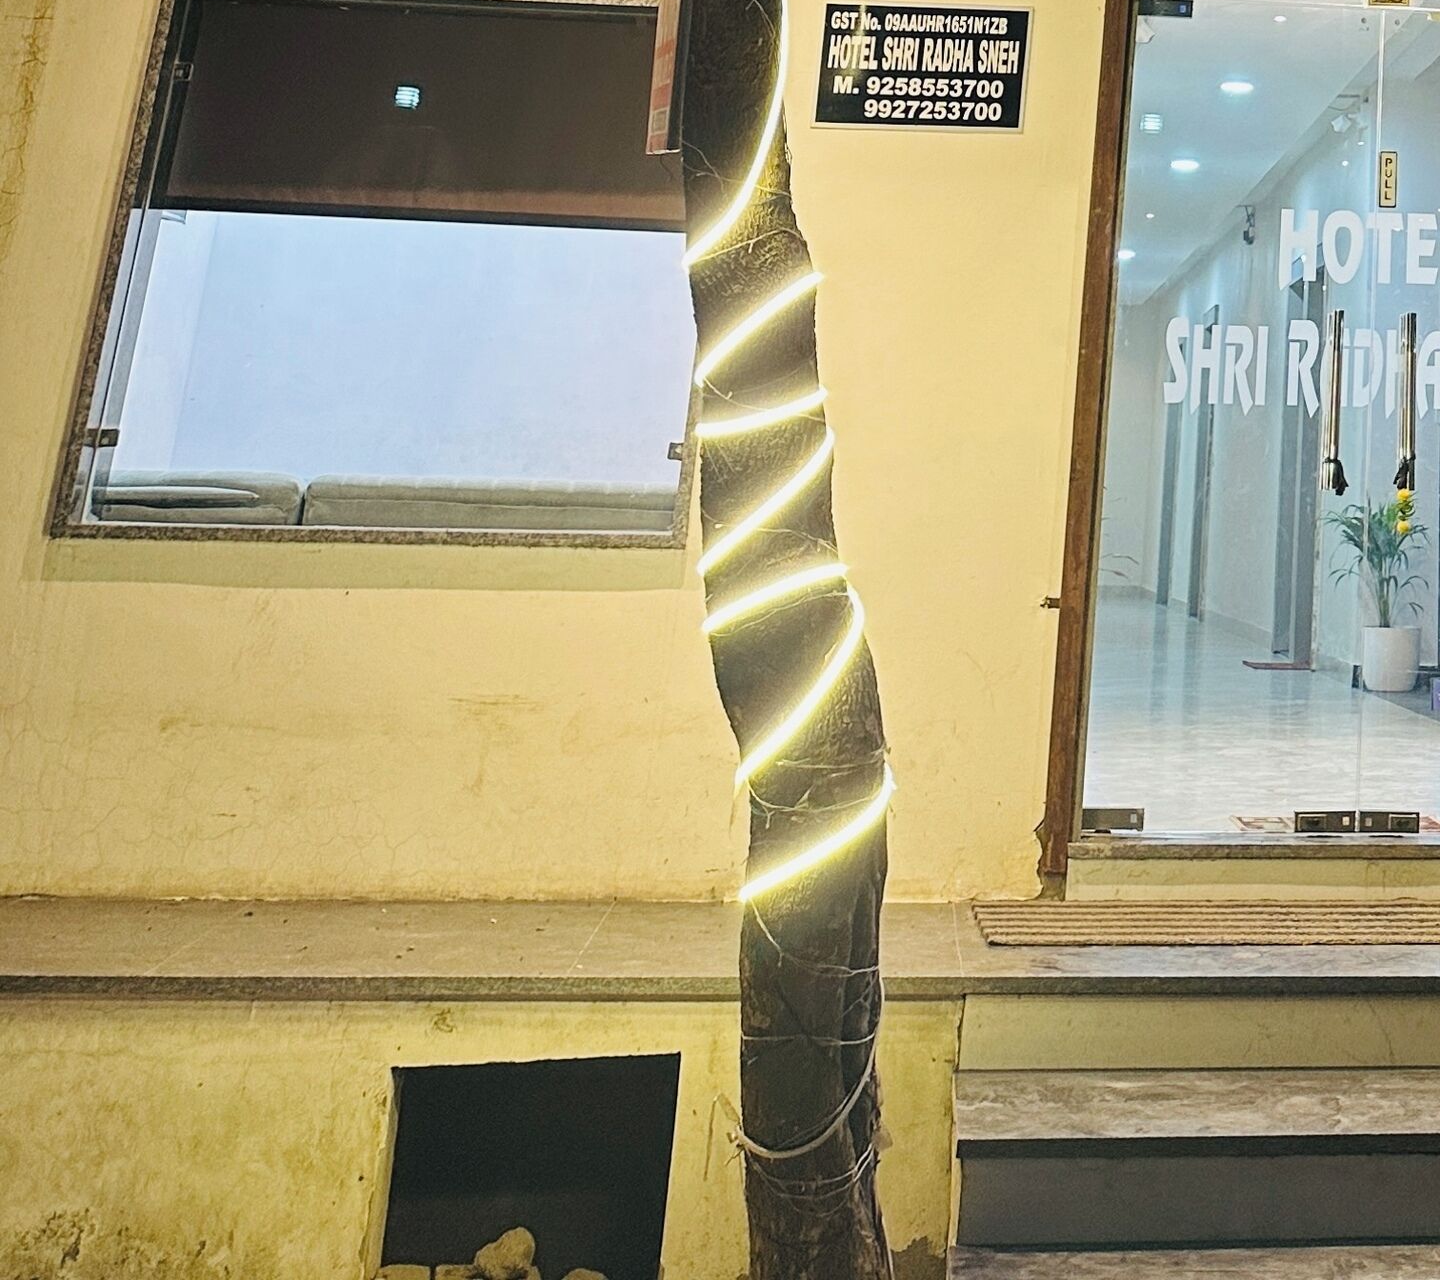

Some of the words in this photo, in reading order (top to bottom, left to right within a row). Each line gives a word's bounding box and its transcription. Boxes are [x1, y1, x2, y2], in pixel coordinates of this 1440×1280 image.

[831, 11, 861, 30] GST
[861, 12, 882, 32] No.
[884, 13, 1008, 35] 09AAUHR1651N1ZB
[827, 35, 878, 70] HOTEL
[881, 36, 920, 72] SHRI
[921, 38, 974, 73] RADHA
[978, 40, 1020, 74] SNEH
[833, 76, 859, 95] M.
[866, 77, 1004, 98] 9258553700
[864, 99, 1002, 121] 9927253700
[1383, 157, 1394, 201] PULL
[1163, 316, 1269, 416] SHRI
